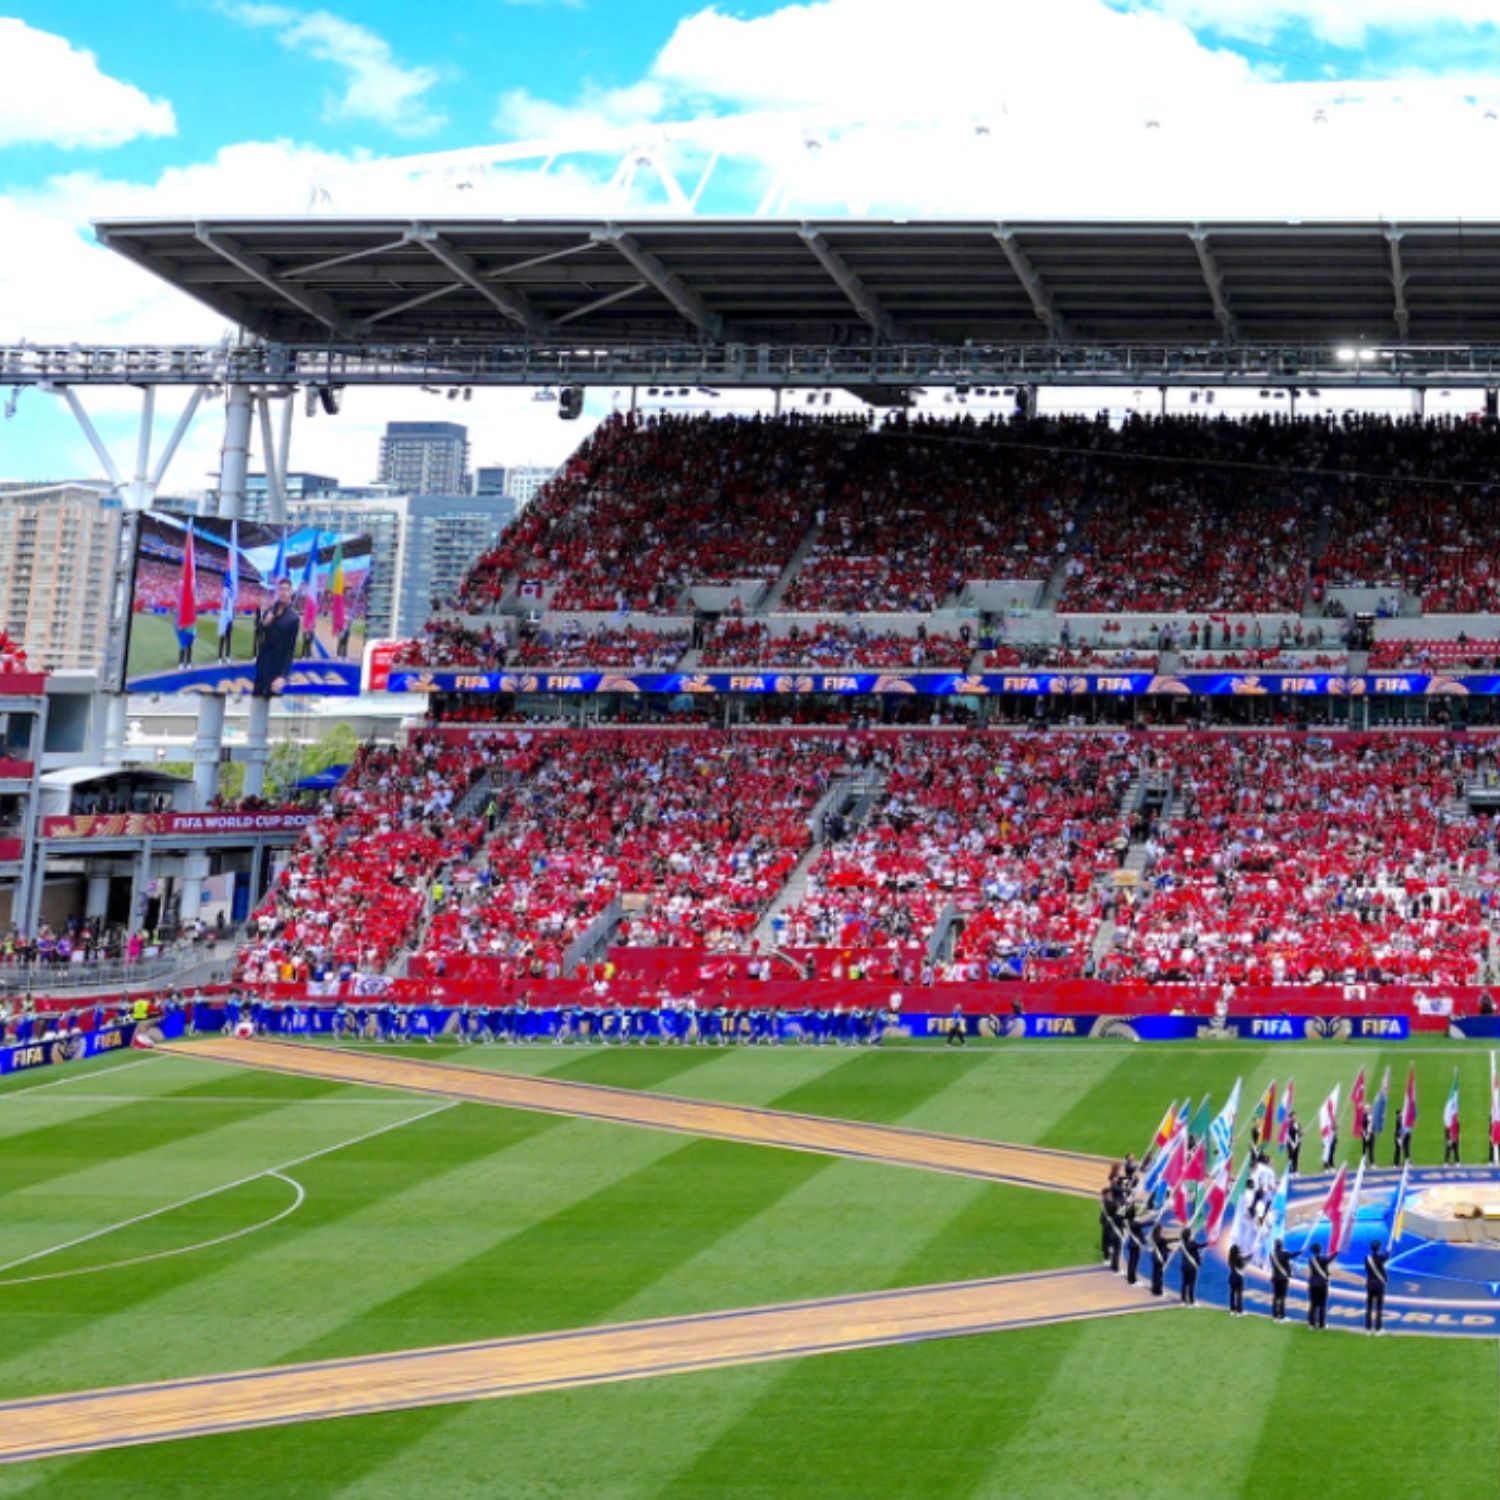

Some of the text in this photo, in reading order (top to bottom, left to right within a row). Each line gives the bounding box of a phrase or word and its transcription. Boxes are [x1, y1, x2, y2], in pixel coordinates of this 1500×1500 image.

[455, 675, 489, 689] FIFA
[547, 675, 582, 689] FIFA
[730, 675, 765, 689] FIFA
[823, 675, 858, 690] FIFA
[1003, 676, 1038, 690] FIFA
[1097, 676, 1132, 690] FIFA
[1281, 677, 1316, 691] FIFA
[1375, 677, 1410, 692] FIFA
[173, 814, 315, 829] FIFA WORLD CUP 20
[1036, 1018, 1075, 1033] FIFA
[1252, 1019, 1292, 1034] FIFA
[1362, 1019, 1401, 1034] FIFA
[94, 1029, 123, 1050] FIFA
[11, 1046, 44, 1067] FIFA
[1328, 1304, 1494, 1326] WORLD
